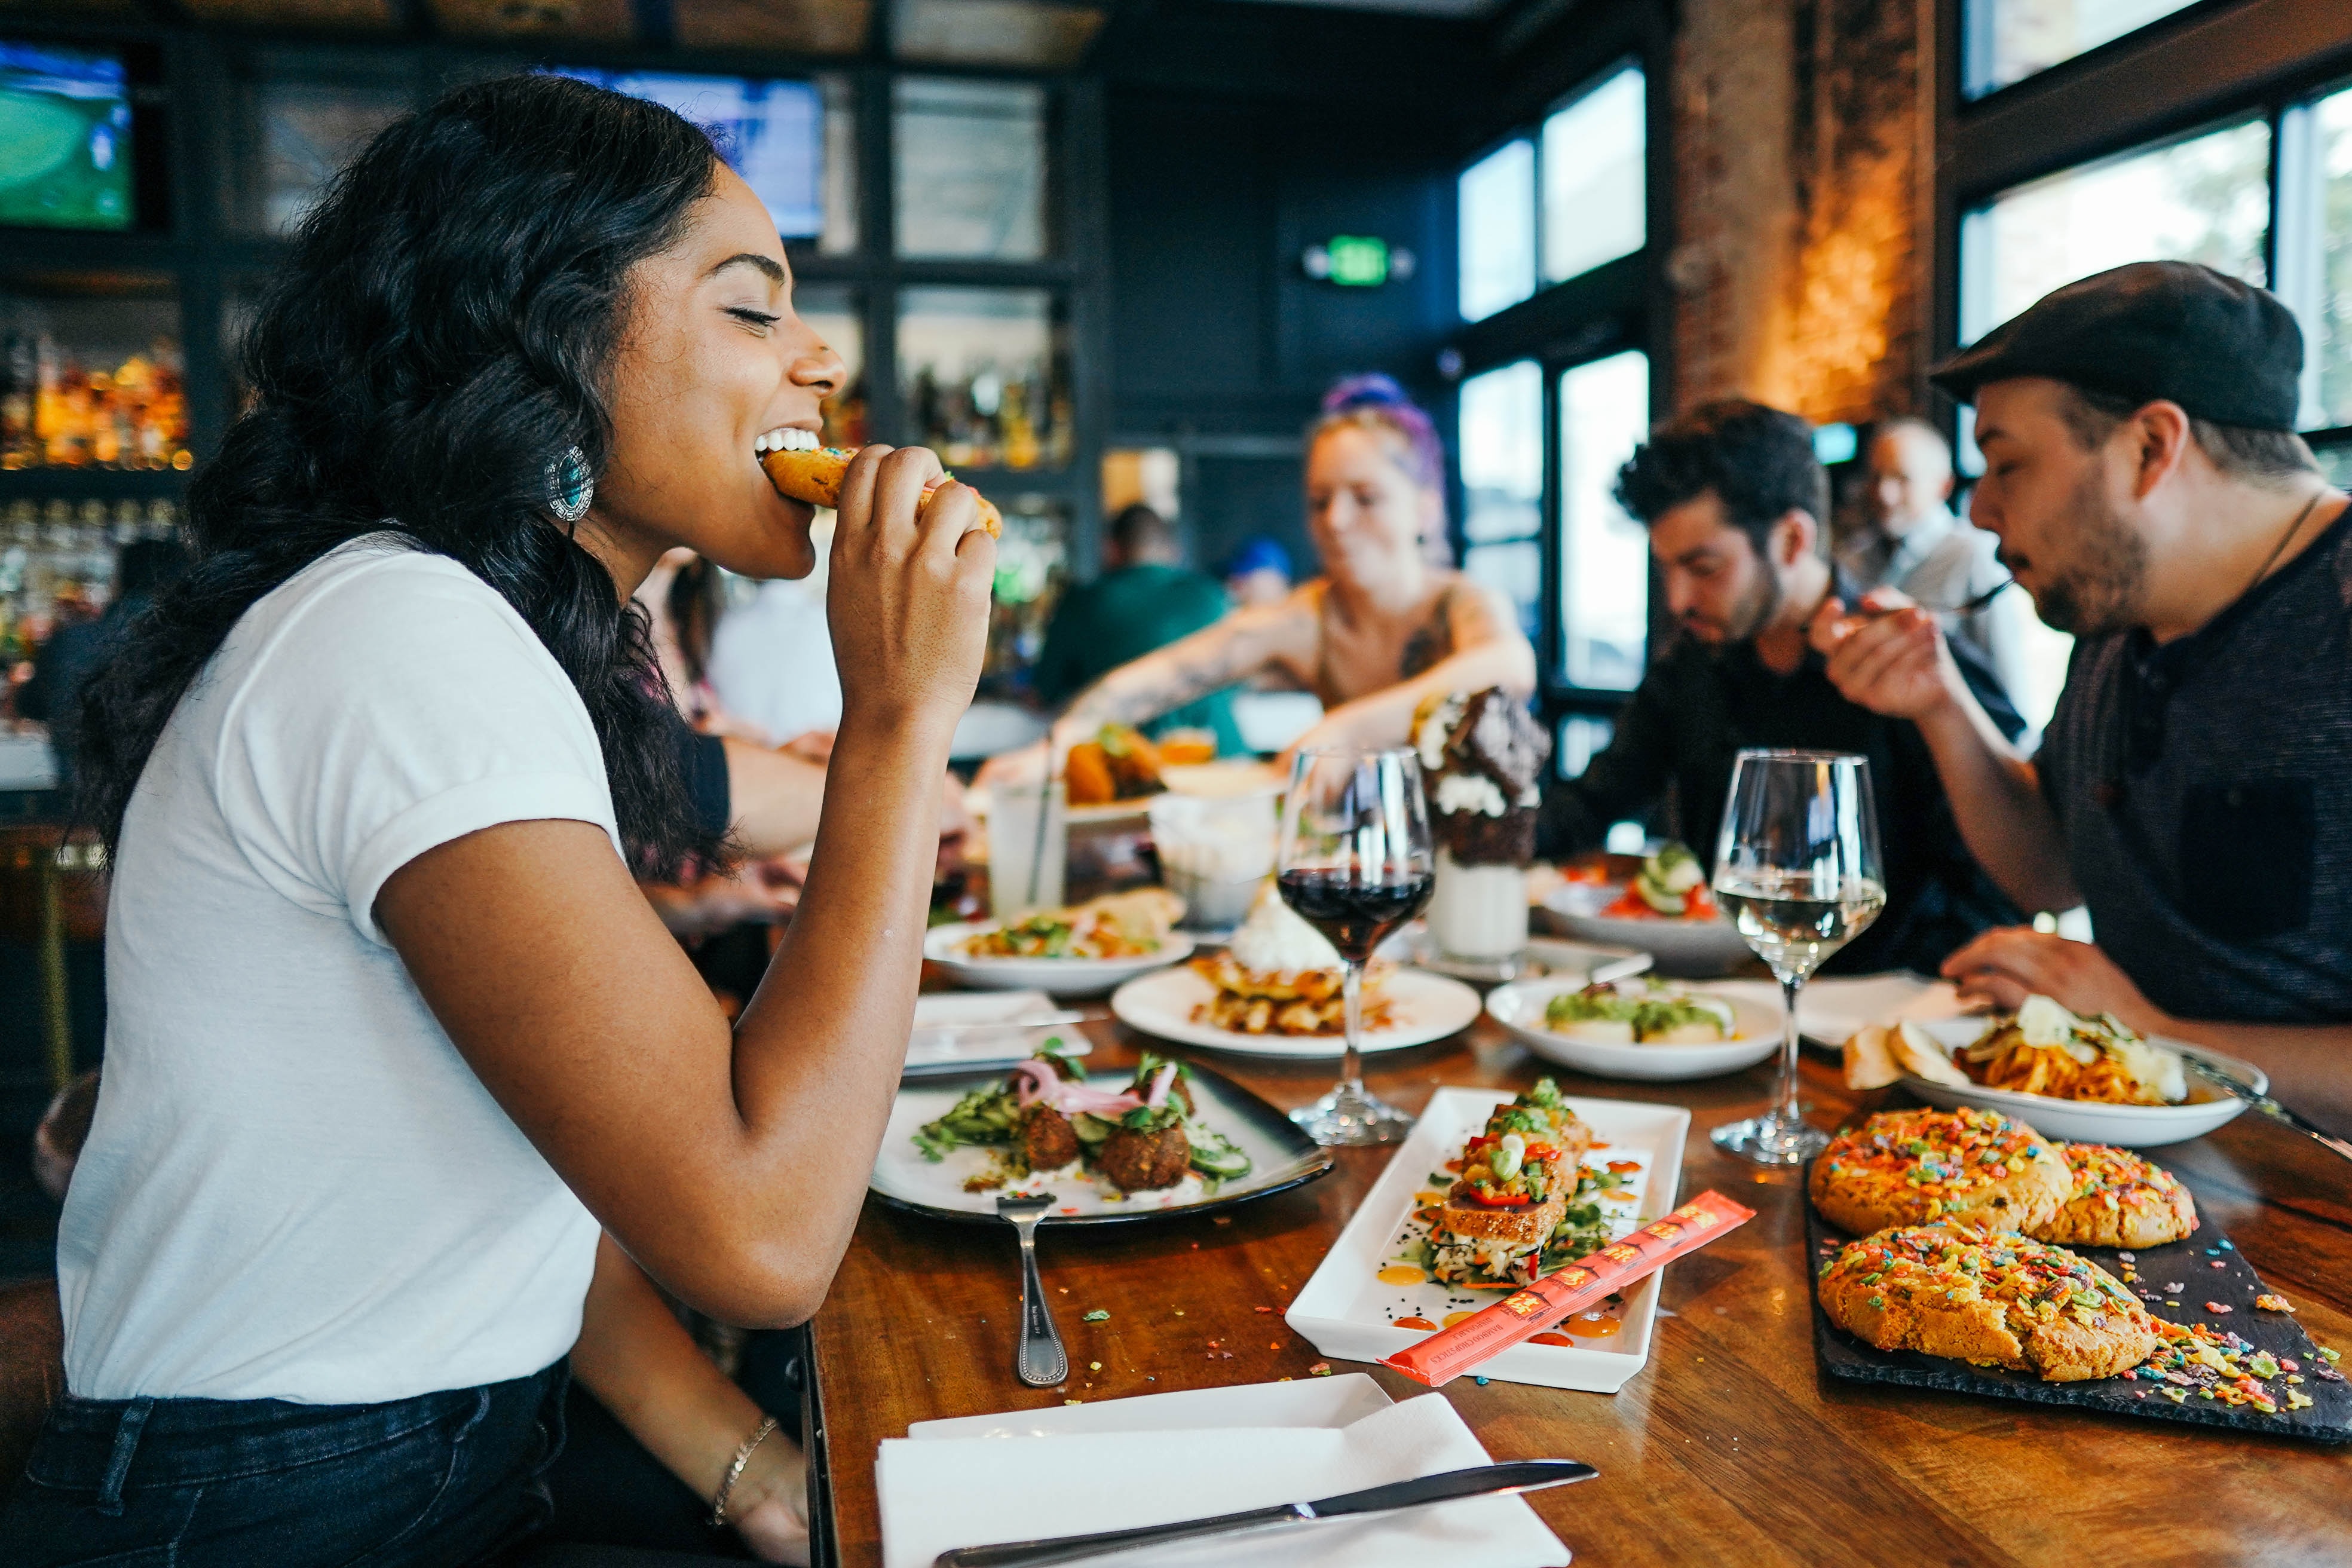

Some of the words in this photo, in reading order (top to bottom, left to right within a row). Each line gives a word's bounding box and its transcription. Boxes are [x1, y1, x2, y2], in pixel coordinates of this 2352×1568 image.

[1451, 1317, 1493, 1340] DISPOSABLE
[1474, 1324, 1503, 1345] BAMBOO
[1430, 1339, 1475, 1364] CHOPSTICKS
